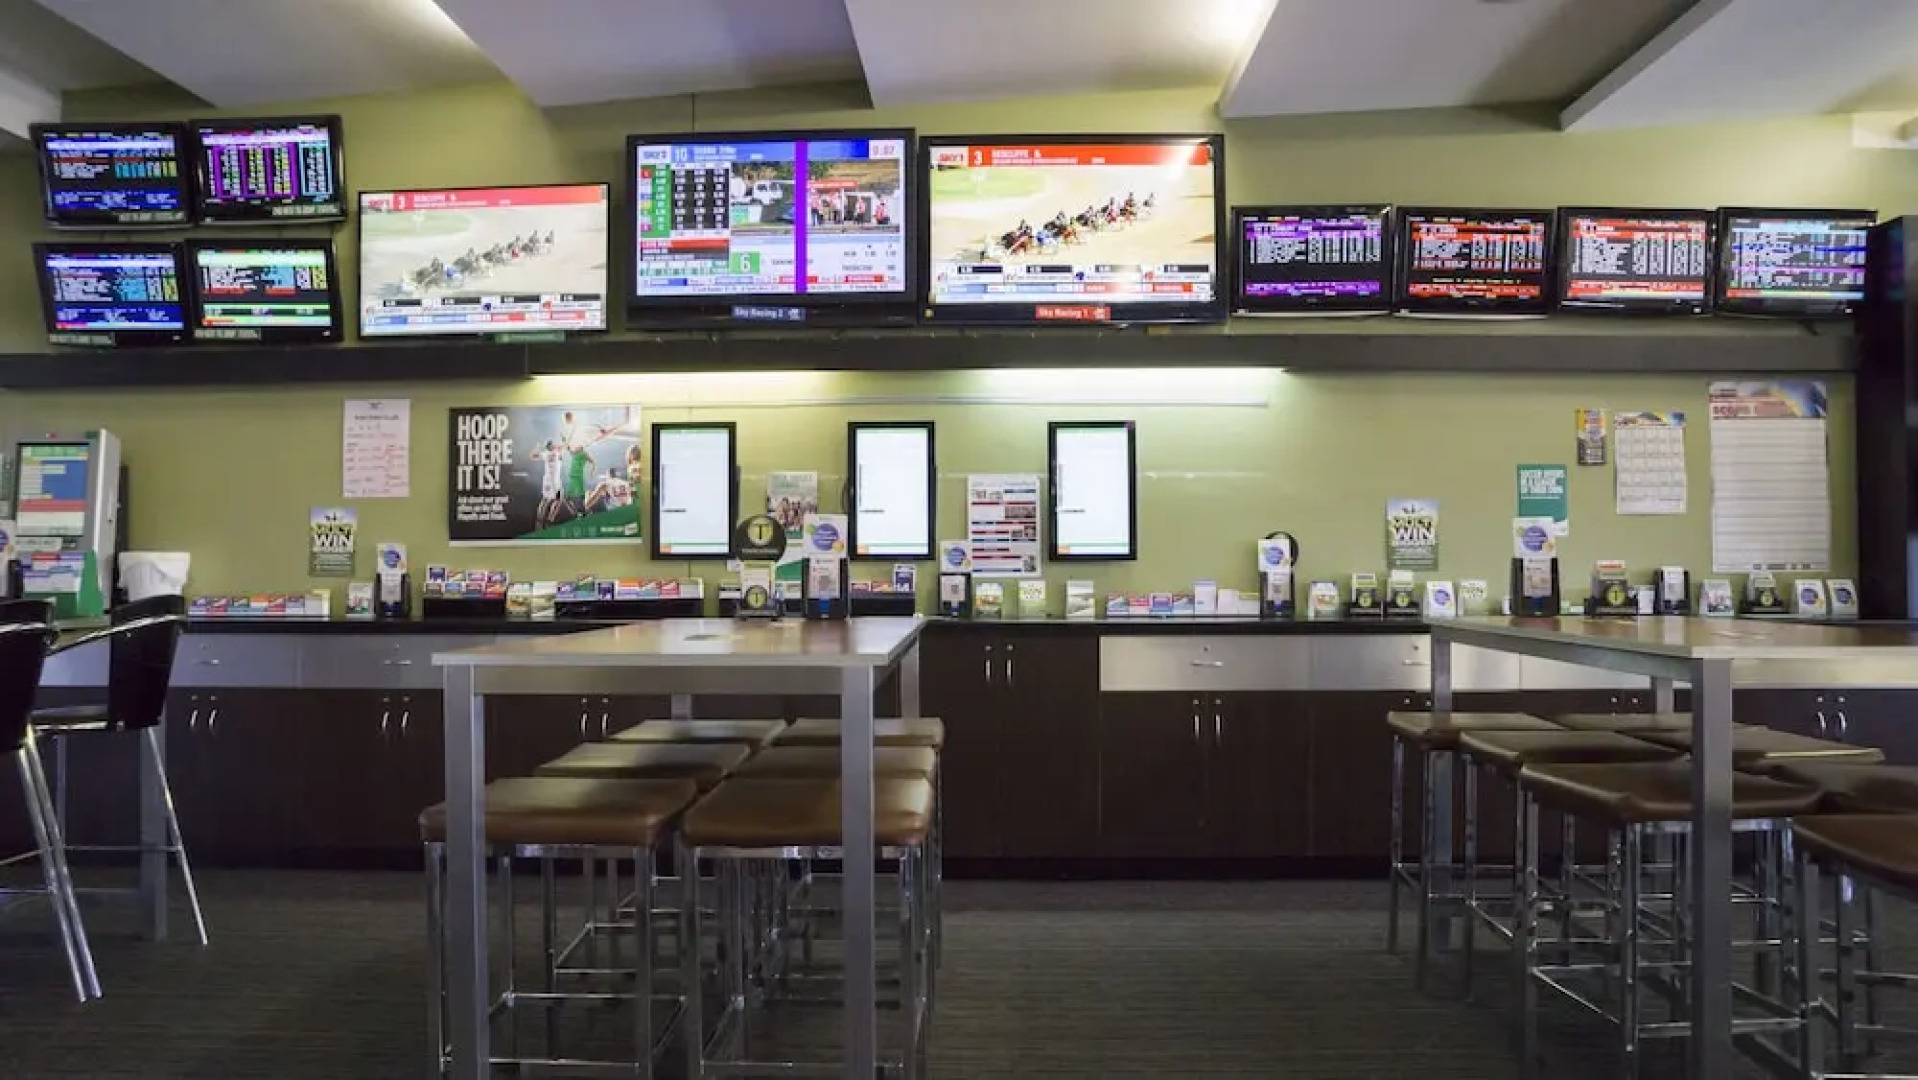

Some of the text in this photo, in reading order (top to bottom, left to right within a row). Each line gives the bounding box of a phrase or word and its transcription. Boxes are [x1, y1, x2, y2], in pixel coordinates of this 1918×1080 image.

[974, 150, 983, 167] 3
[457, 414, 508, 440] HOOP
[457, 439, 513, 465] THERE
[457, 465, 501, 491] IT IS!
[315, 533, 353, 549] WIN
[1395, 527, 1435, 541] WIN
